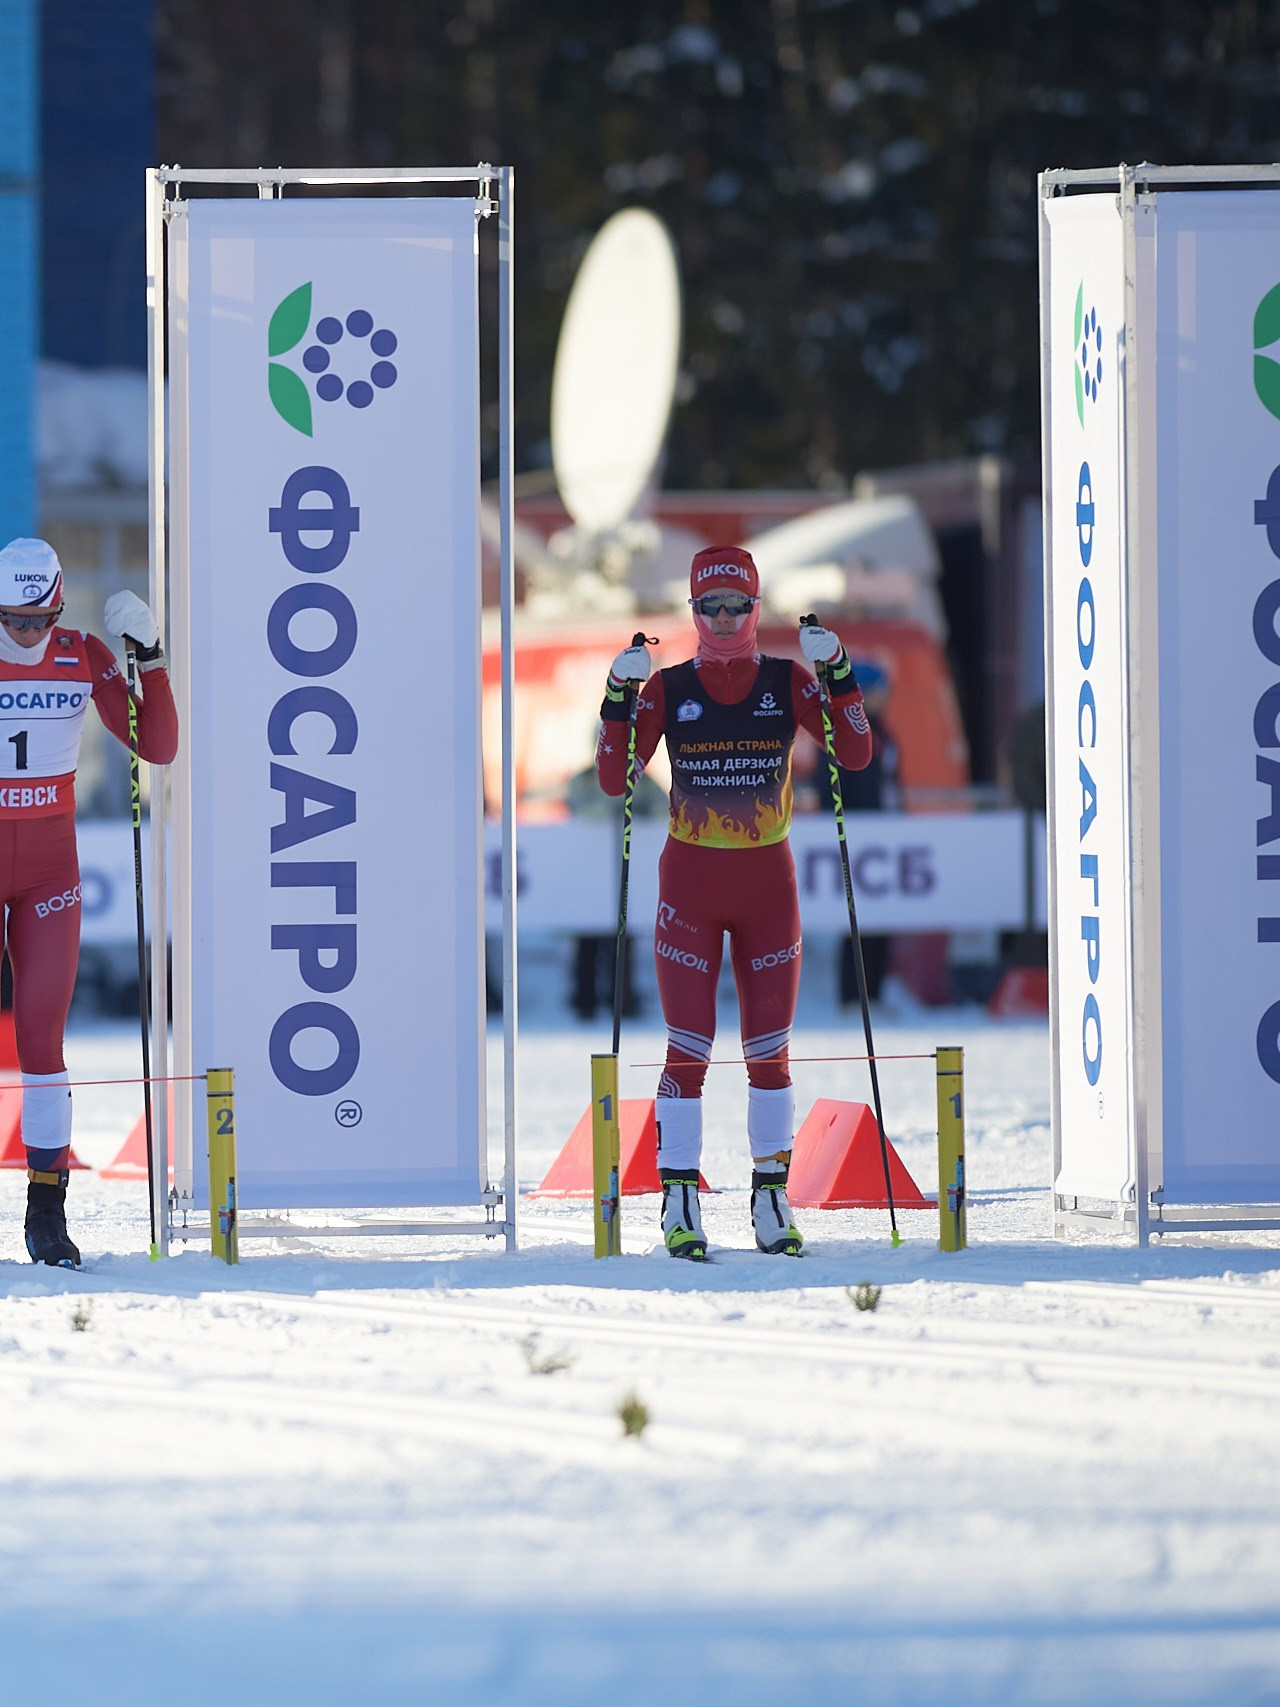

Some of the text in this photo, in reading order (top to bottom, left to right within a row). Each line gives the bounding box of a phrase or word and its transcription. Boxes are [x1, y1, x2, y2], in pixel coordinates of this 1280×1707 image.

[14, 573, 49, 582] LUKOIL
[697, 563, 750, 582] LUKOIL
[753, 709, 784, 717] ФОСАГРО
[8, 731, 28, 770] 1
[679, 740, 782, 753] ЛЫЖНАЯ СТРАНА
[675, 756, 783, 772] САМАЯ ДЕРЗКАЯ
[1076, 462, 1103, 1087] ФОСАГРО
[267, 466, 360, 1097] ФОСАГРО
[692, 774, 766, 787] ЛЫЖНИЦА
[806, 846, 937, 898] ПСБ
[656, 939, 709, 973] LUKOIL
[598, 1094, 613, 1121] 1
[948, 1091, 963, 1120] 1
[215, 1108, 234, 1136] 2
